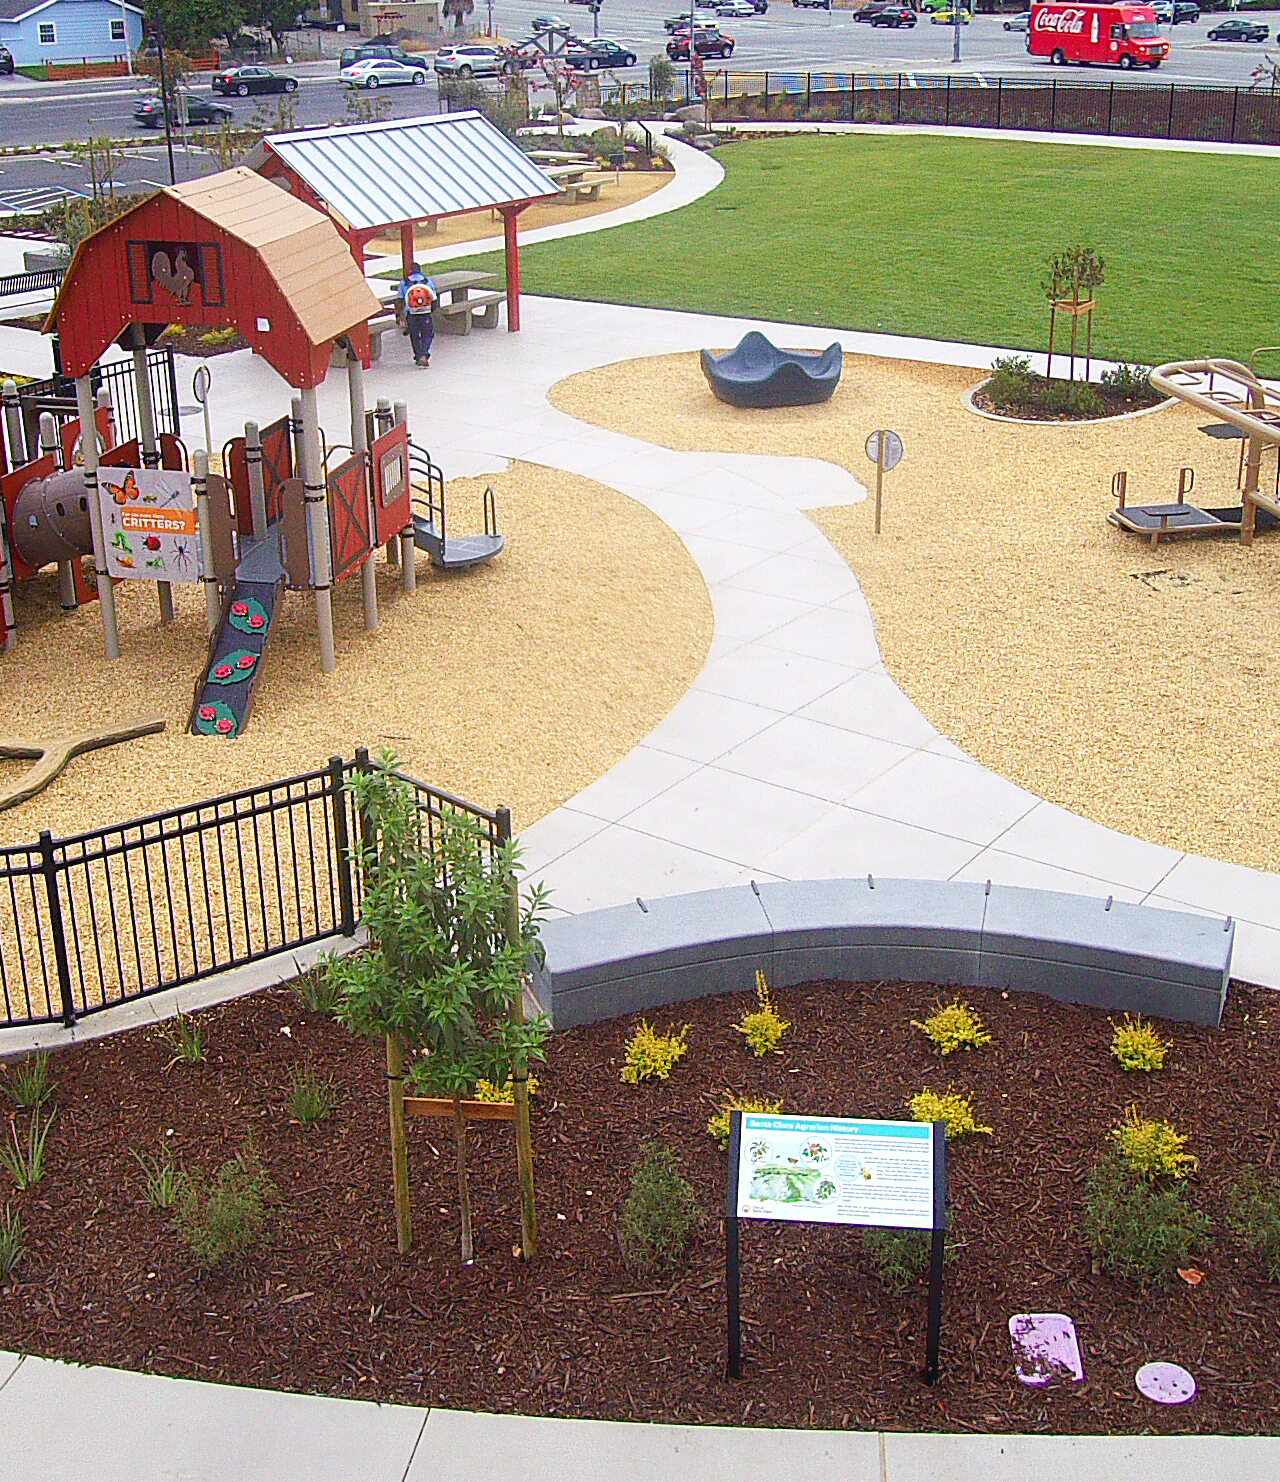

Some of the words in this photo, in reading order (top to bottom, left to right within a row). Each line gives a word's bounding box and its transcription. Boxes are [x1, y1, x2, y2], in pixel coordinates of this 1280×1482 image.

[122, 517, 185, 530] CRITTERS?
[772, 1120, 794, 1129] Clara
[830, 1124, 859, 1134] History
